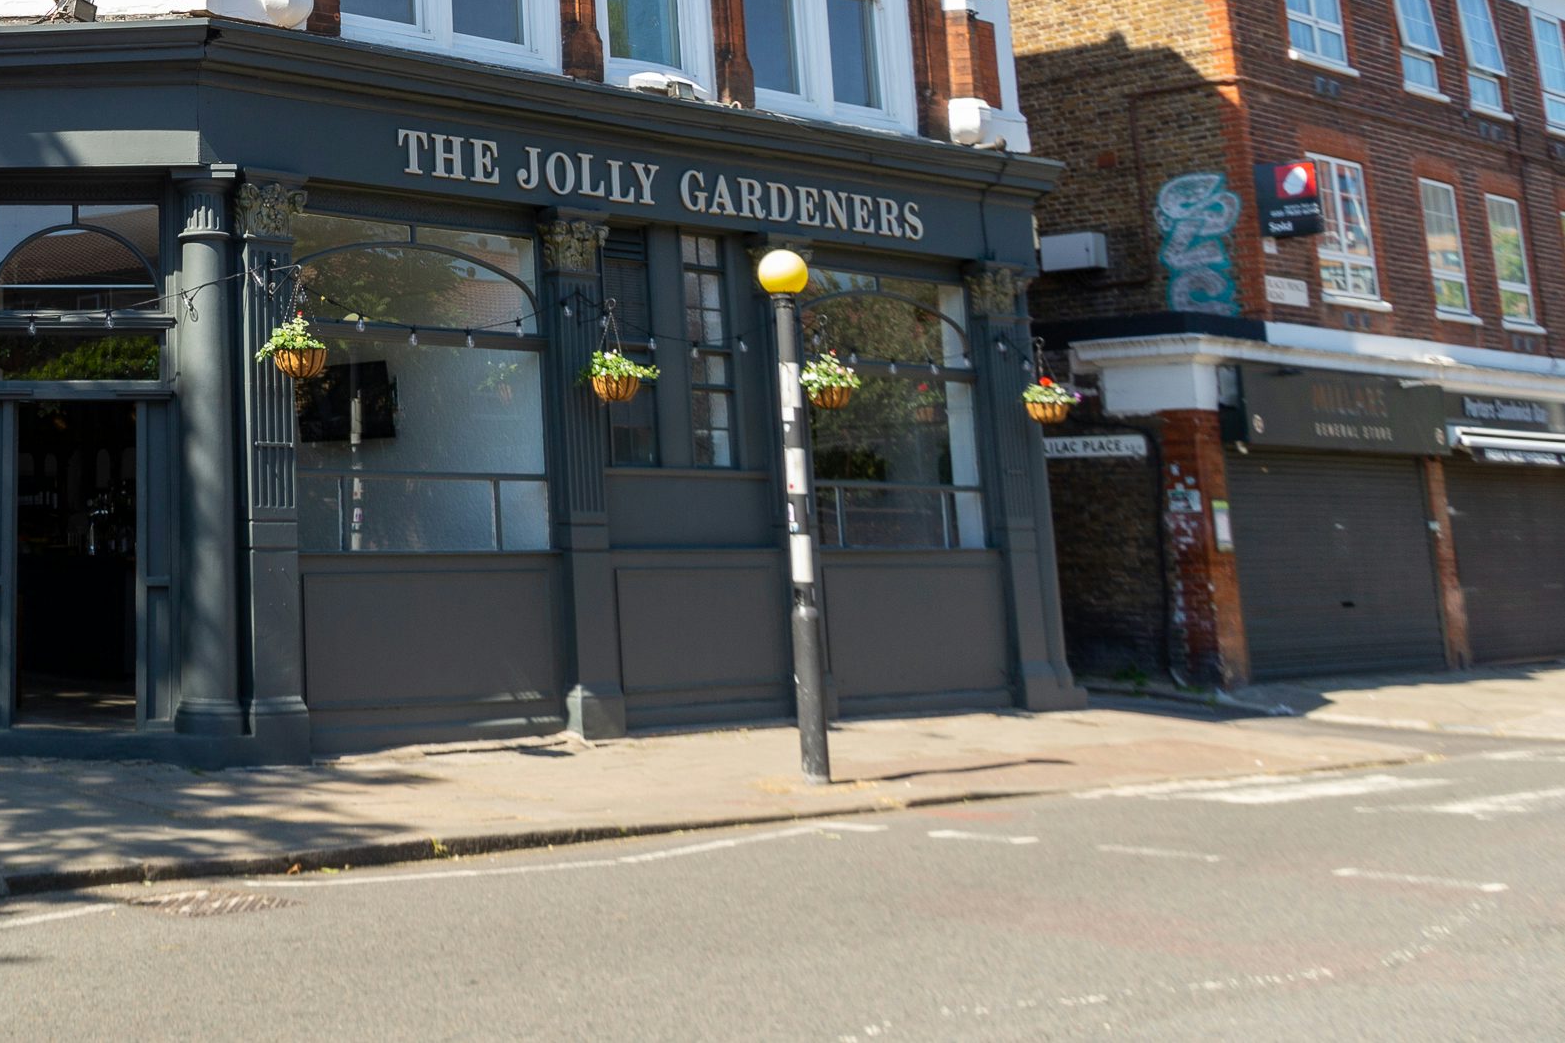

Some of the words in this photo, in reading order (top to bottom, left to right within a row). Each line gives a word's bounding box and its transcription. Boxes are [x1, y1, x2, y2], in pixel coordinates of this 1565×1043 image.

[398, 129, 500, 185] THE
[516, 145, 660, 206] JOLLY
[679, 169, 925, 241] GARDENERS
[1315, 422, 1360, 439] GENERAL
[1362, 425, 1394, 442] STORE
[1082, 439, 1123, 453] PLACE
